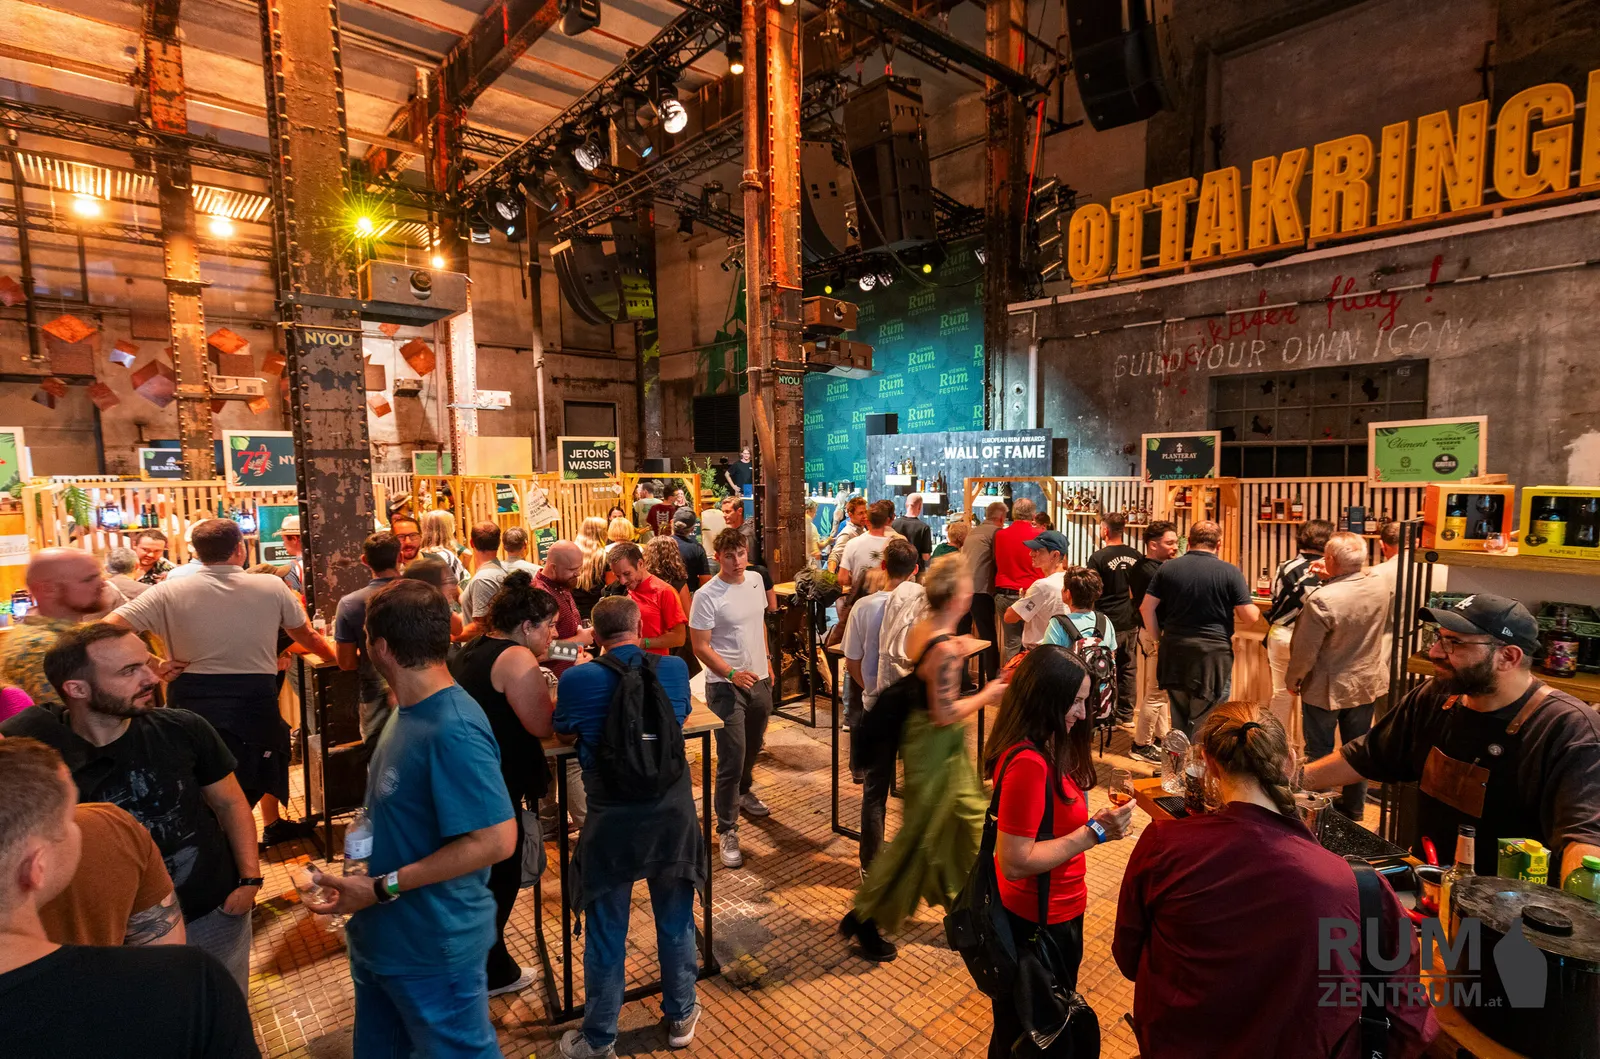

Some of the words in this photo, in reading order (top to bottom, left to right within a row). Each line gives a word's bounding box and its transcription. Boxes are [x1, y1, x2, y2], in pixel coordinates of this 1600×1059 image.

[908, 292, 936, 310] Rum
[856, 304, 875, 317] um
[908, 305, 936, 316] FESTIVAL
[940, 312, 969, 329] Rum
[879, 322, 904, 338] Rum
[940, 324, 969, 336] FESTIVAL
[305, 331, 353, 347] NYOU
[878, 335, 904, 345] FESTIVAL
[1194, 339, 1266, 372] YOUR
[1373, 317, 1463, 360] ICON
[908, 350, 936, 366] Rum
[907, 363, 936, 374] FESTIVAL
[779, 375, 800, 385] NYOU
[879, 378, 904, 392] Rum
[939, 372, 969, 387] Rum
[827, 382, 849, 396] Rum
[878, 389, 904, 399] FESTIVAL
[939, 384, 969, 395] FESTIVAL
[826, 393, 849, 402] FESTIVAL
[803, 413, 824, 426] Rum
[852, 410, 868, 423] Ru
[908, 407, 935, 421] Rum
[803, 423, 824, 431] FESTIVAL
[852, 422, 867, 430] FESTI
[907, 420, 936, 429] FESTIVAL
[827, 433, 849, 446] Rum
[569, 449, 610, 459] JETONS
[827, 444, 849, 452] FESTIVAL
[943, 446, 979, 459] WALL
[981, 445, 1001, 459] OF
[1004, 444, 1046, 459] FAME
[237, 451, 272, 474] 77
[568, 460, 612, 470] WASSER
[804, 461, 825, 473] Rum
[853, 462, 867, 474] Ru
[805, 471, 825, 480] FESTIVAL
[1107, 555, 1138, 571] BILLABONG
